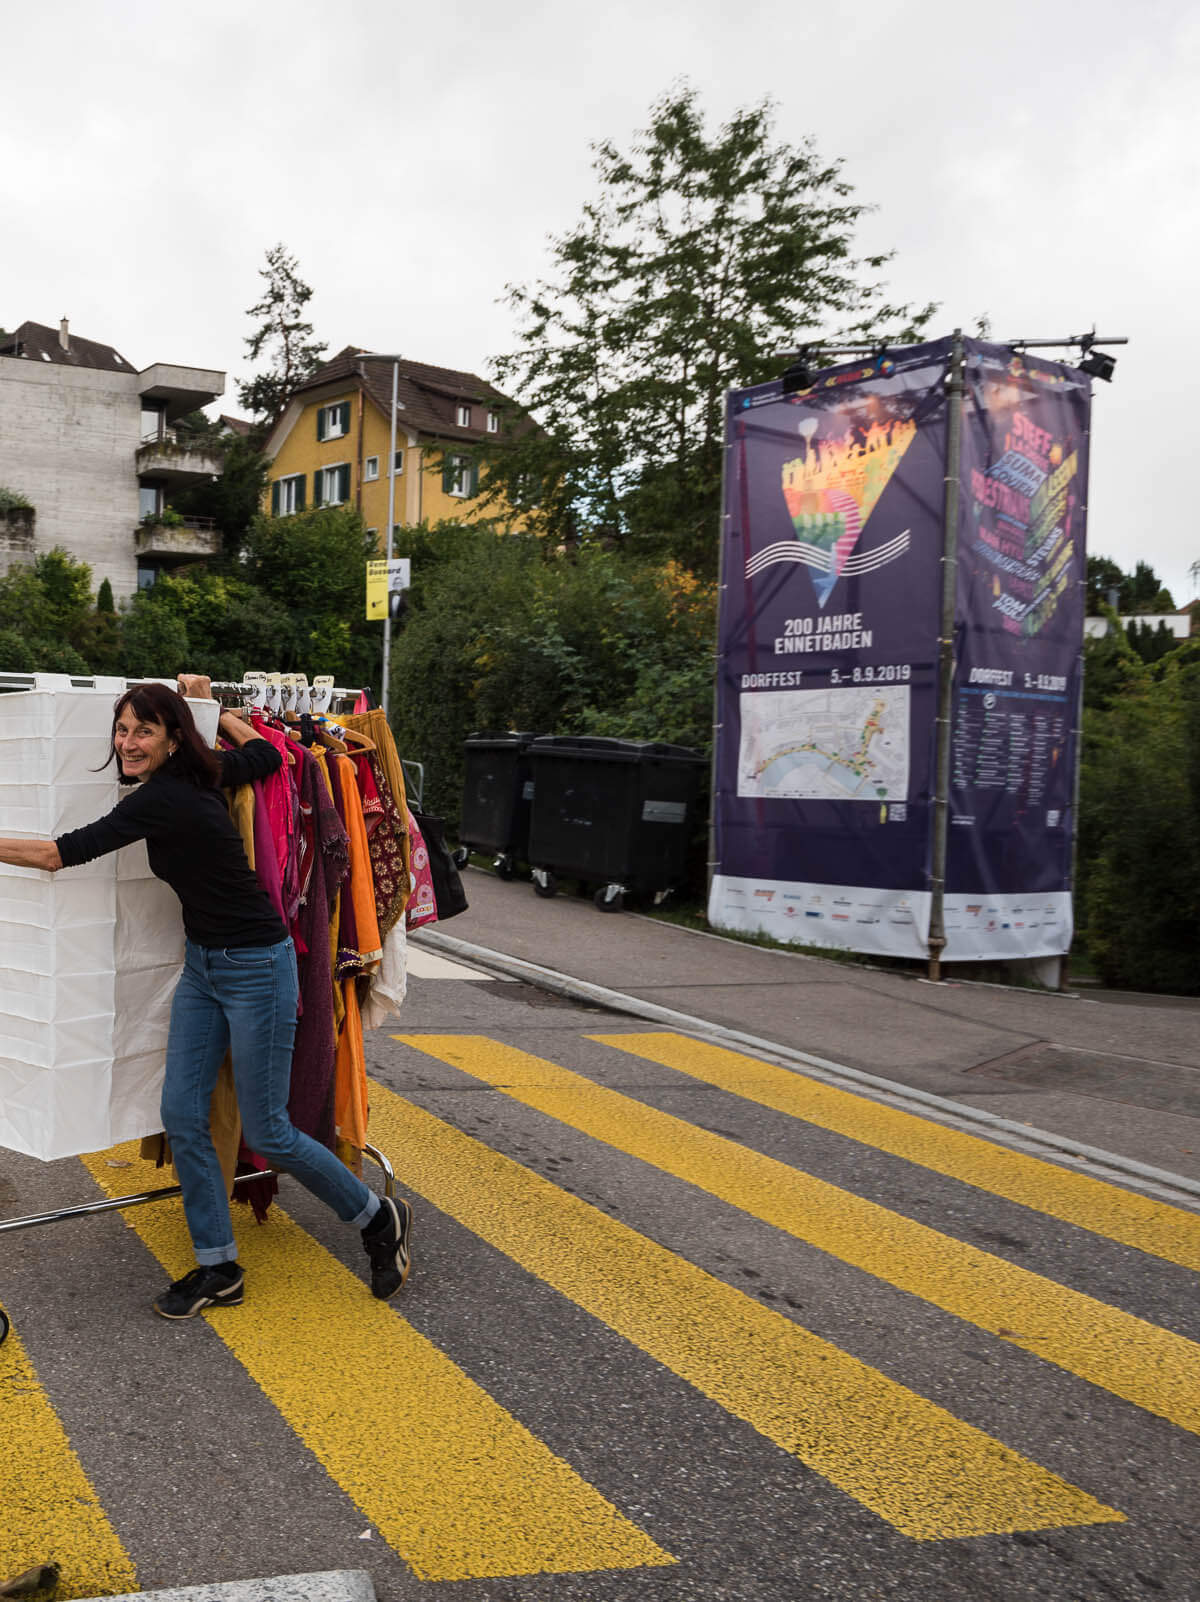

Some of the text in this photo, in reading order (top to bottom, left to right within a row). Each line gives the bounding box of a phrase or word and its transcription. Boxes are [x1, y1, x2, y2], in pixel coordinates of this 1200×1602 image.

[784, 612, 863, 637] 200 JAHRE
[774, 630, 873, 655] ENNETBADEN
[741, 671, 803, 689] DORFFEST
